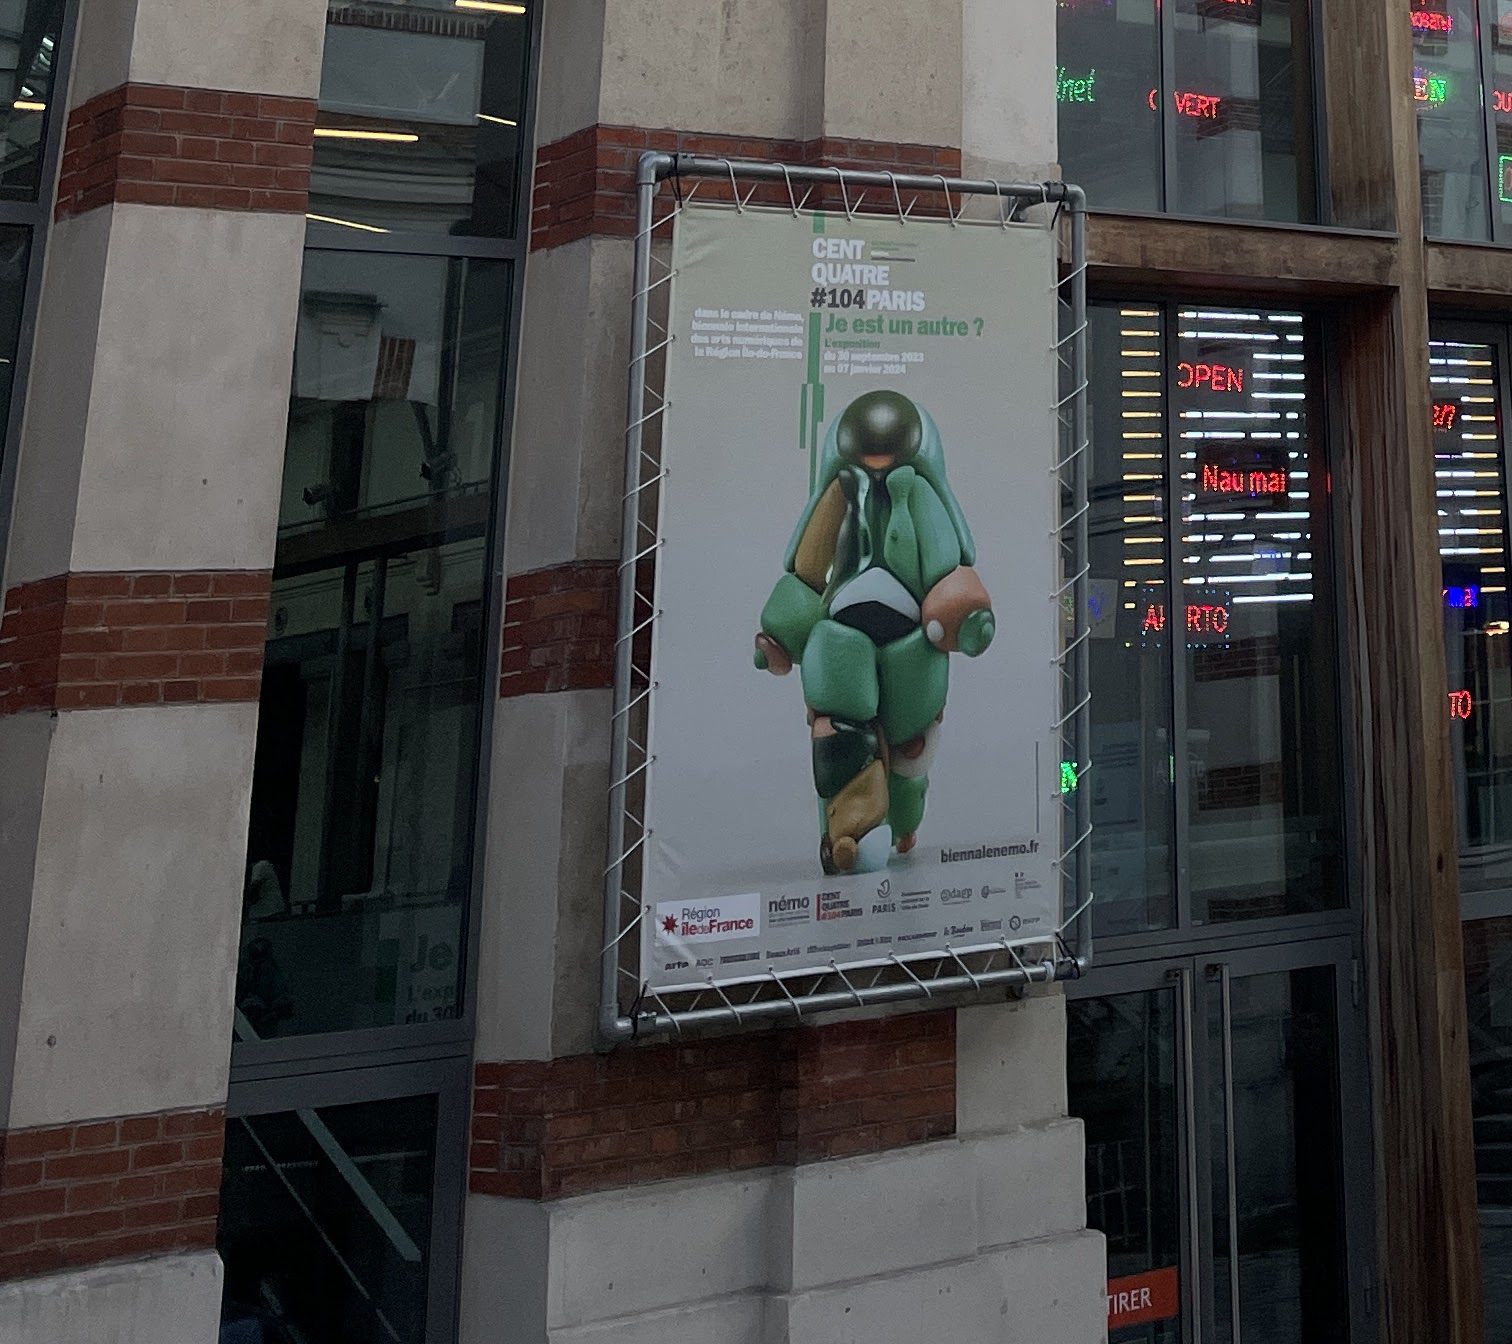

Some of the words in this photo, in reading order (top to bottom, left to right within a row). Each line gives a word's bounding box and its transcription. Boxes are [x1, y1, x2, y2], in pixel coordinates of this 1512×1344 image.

[1411, 76, 1447, 103] EN
[1149, 88, 1221, 119] OVERT
[812, 238, 866, 260] CENT
[811, 262, 890, 287] QUATRE
[825, 313, 848, 334] Je
[852, 314, 884, 334] est
[888, 319, 913, 335] un
[917, 316, 969, 336] autre
[973, 317, 985, 337] ?
[1177, 363, 1244, 393] OPEN
[1202, 464, 1244, 493] Nau
[1249, 466, 1287, 494] mai
[940, 839, 1040, 864] biennalenemo.fr
[681, 905, 721, 923] Région
[767, 895, 811, 912] némo
[872, 903, 896, 914] PARIS
[665, 961, 689, 970] arte
[1107, 1287, 1153, 1315] TIRER
